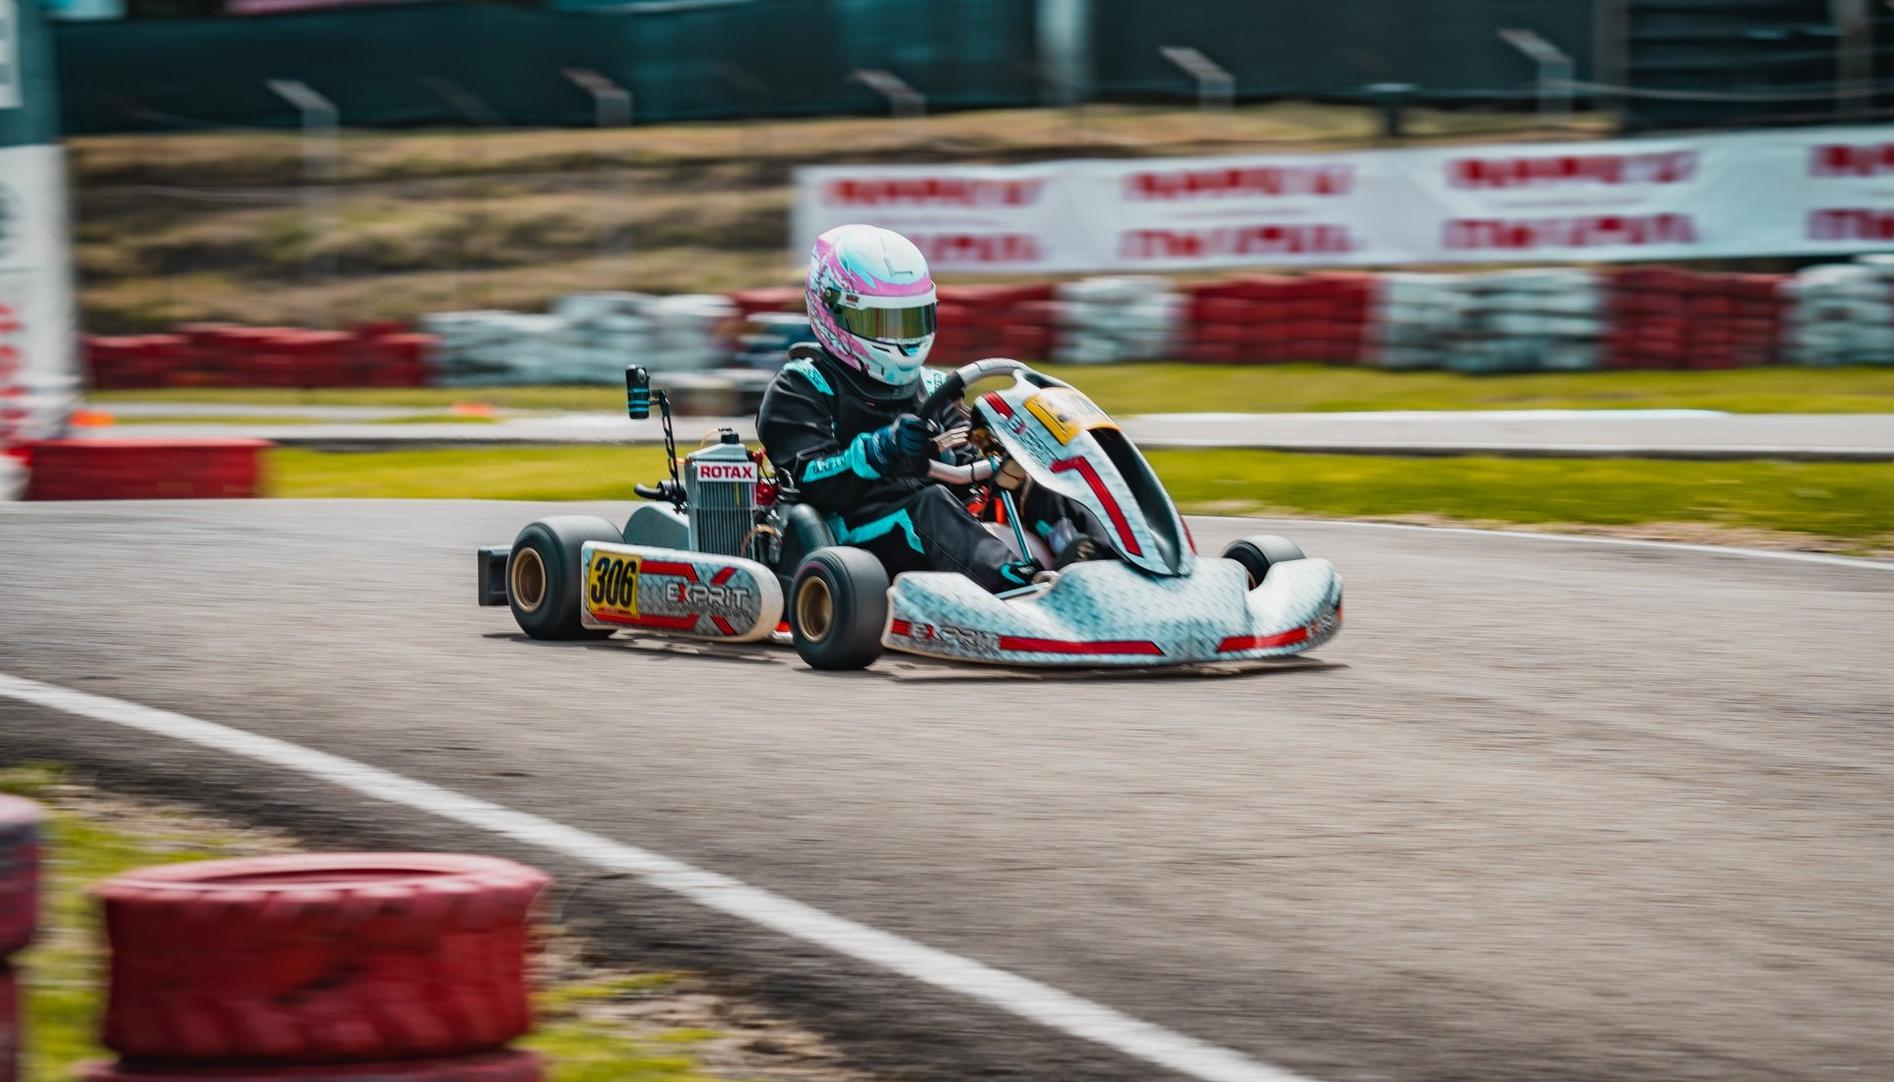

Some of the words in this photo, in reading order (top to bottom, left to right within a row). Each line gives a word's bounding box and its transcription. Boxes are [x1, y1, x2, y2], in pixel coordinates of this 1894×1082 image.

[700, 466, 752, 479] ROTAX
[591, 557, 637, 607] 306
[666, 583, 749, 609] EXPRIT
